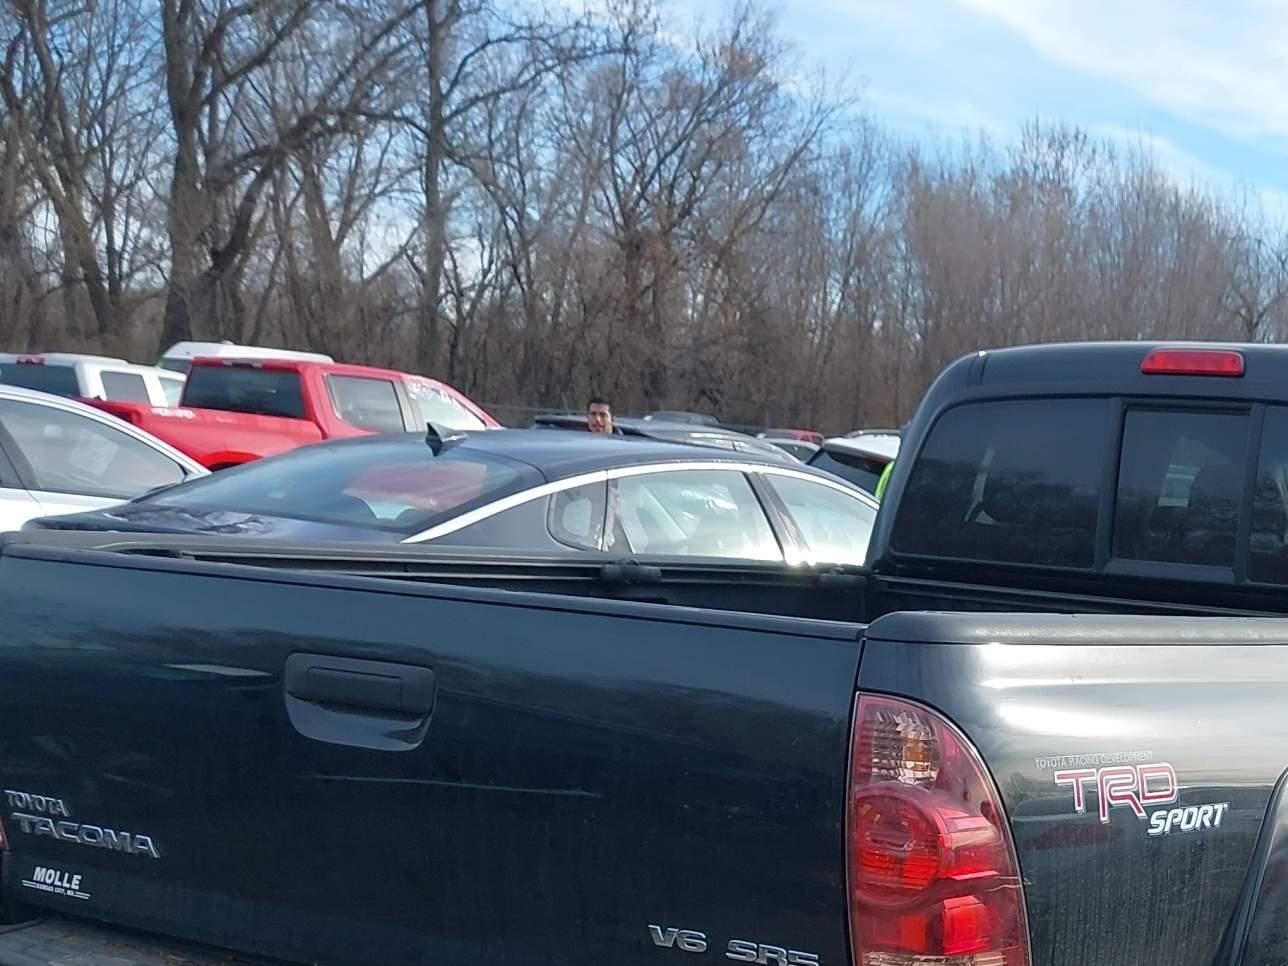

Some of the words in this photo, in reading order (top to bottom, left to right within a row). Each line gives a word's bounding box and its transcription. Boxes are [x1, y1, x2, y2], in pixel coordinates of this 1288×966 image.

[1034, 755, 1067, 769] TOYOTA
[4, 789, 70, 817] TOYOTA
[1054, 762, 1178, 823] TRD
[1147, 803, 1229, 836] SPORT
[11, 812, 161, 858] TACOMA
[33, 866, 82, 890] MOLLE
[648, 924, 707, 952] V6
